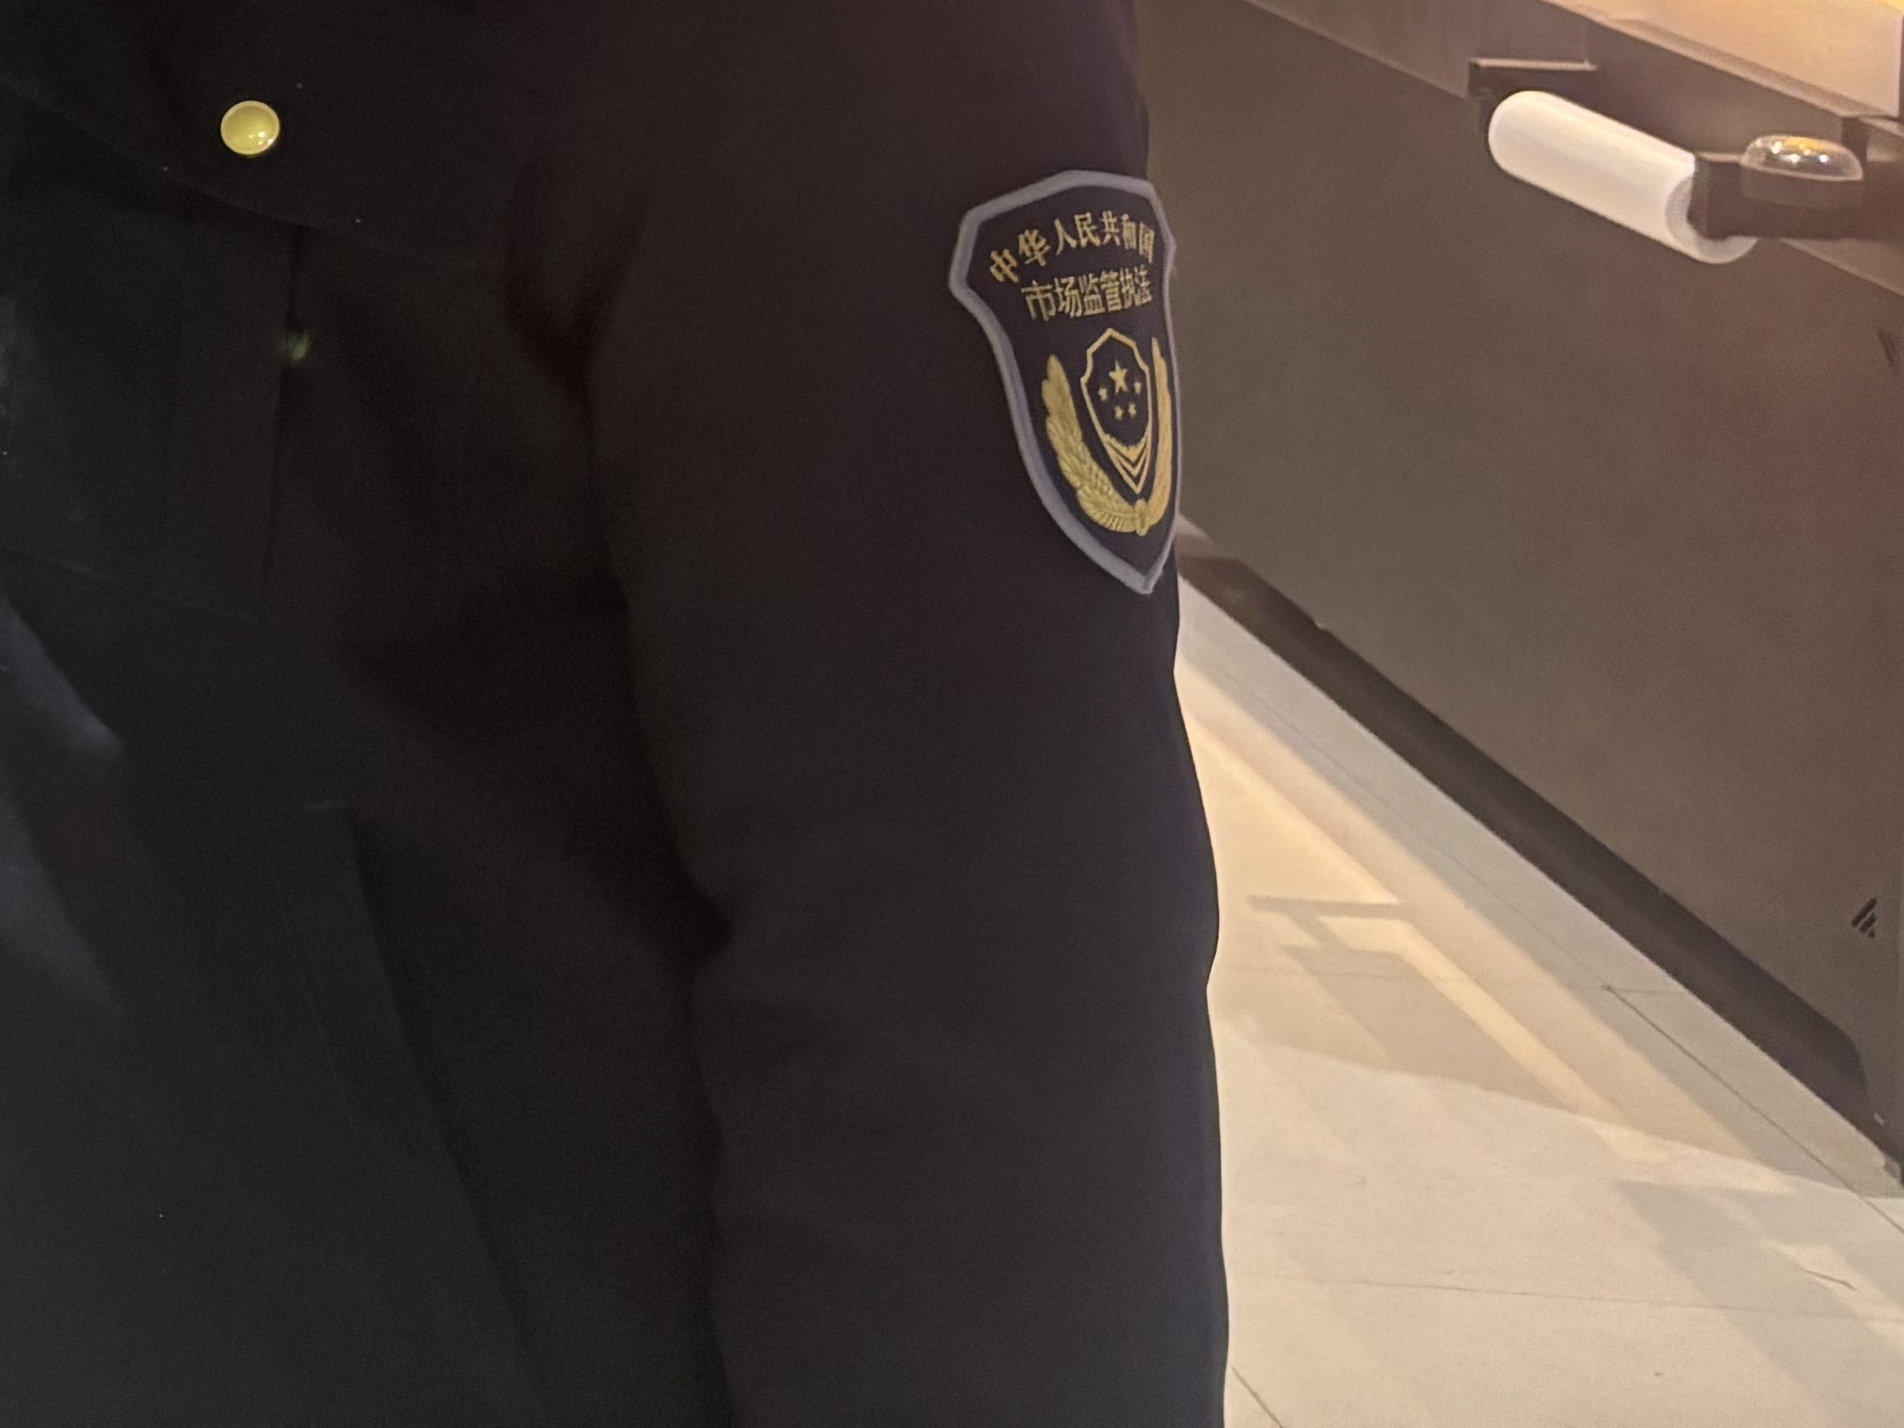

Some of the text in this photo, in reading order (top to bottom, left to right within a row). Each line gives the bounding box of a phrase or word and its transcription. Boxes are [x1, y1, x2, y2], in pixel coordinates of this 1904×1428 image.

[989, 210, 1156, 285] 中华人民共和国
[1020, 263, 1153, 322] 市场监管执法
